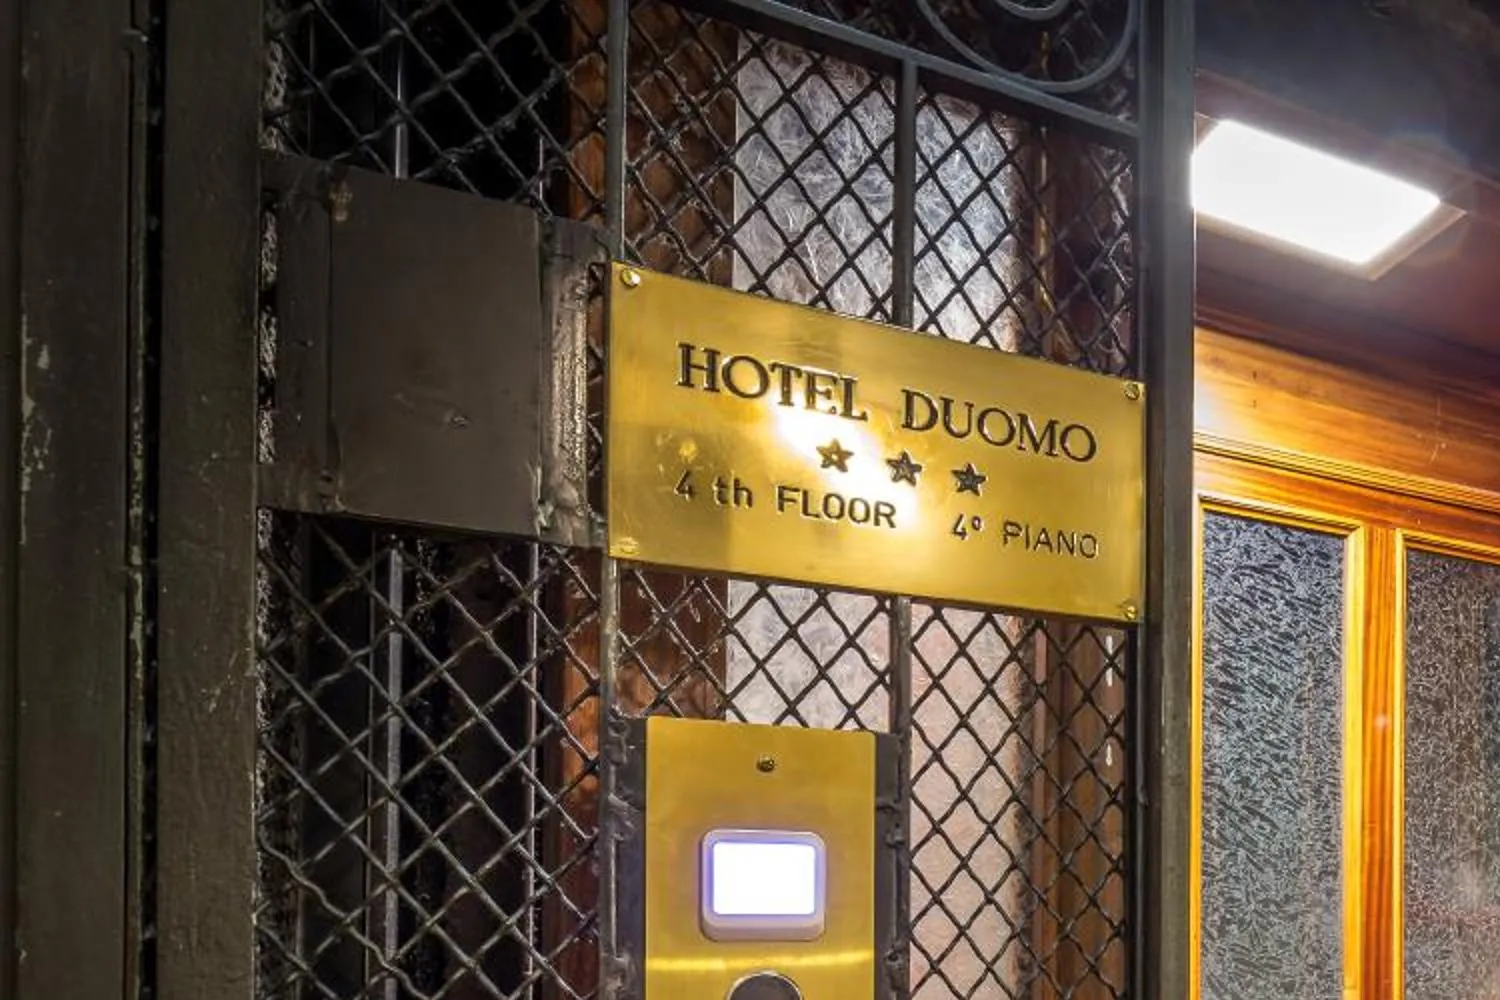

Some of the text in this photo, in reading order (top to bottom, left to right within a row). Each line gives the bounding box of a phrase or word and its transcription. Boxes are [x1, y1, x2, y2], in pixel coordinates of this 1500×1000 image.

[676, 343, 1098, 463] HOTEL DUOMO
[673, 469, 897, 529] 4 th FLOOR
[1002, 520, 1098, 559] PIANO
